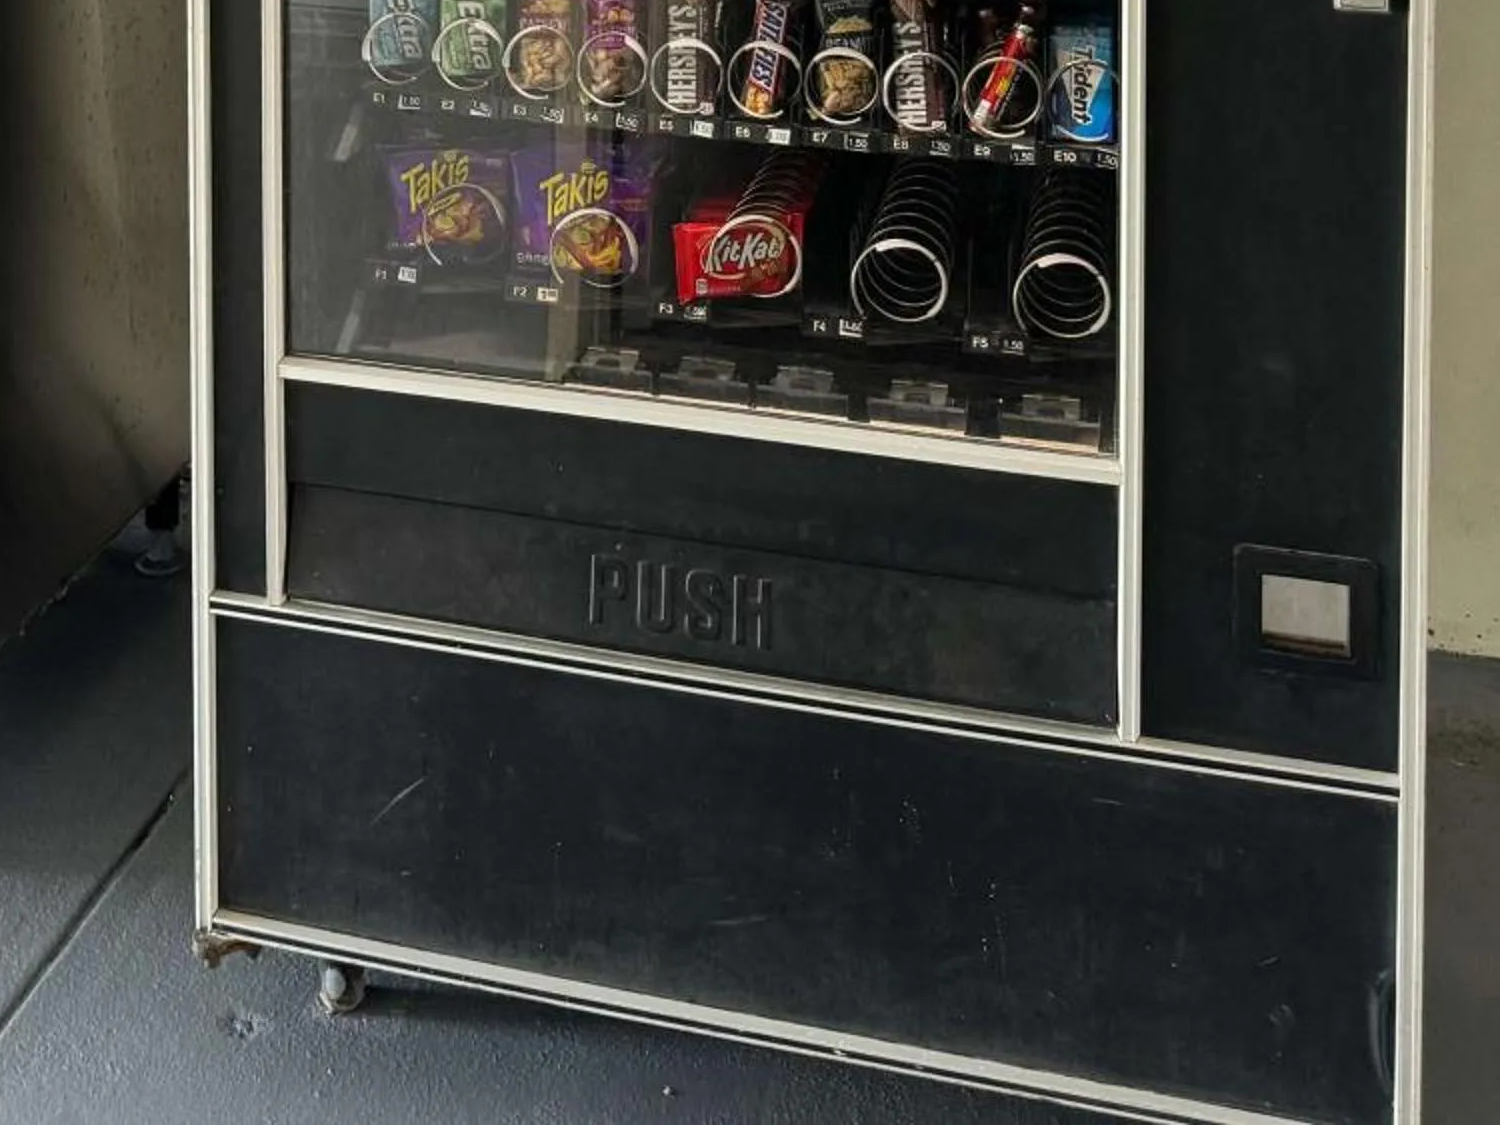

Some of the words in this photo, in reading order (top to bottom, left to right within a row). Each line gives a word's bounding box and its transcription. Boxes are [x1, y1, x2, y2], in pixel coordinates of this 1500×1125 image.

[735, 126, 751, 138] E6
[813, 131, 828, 142] E7
[974, 144, 991, 156] E9
[1053, 150, 1077, 162] E10
[401, 153, 471, 214] Takis
[539, 168, 609, 225] Takis
[512, 286, 528, 298] F2
[659, 303, 674, 315] F3
[813, 320, 826, 332] F4
[973, 337, 989, 349] F5
[587, 553, 774, 651] PUSH
